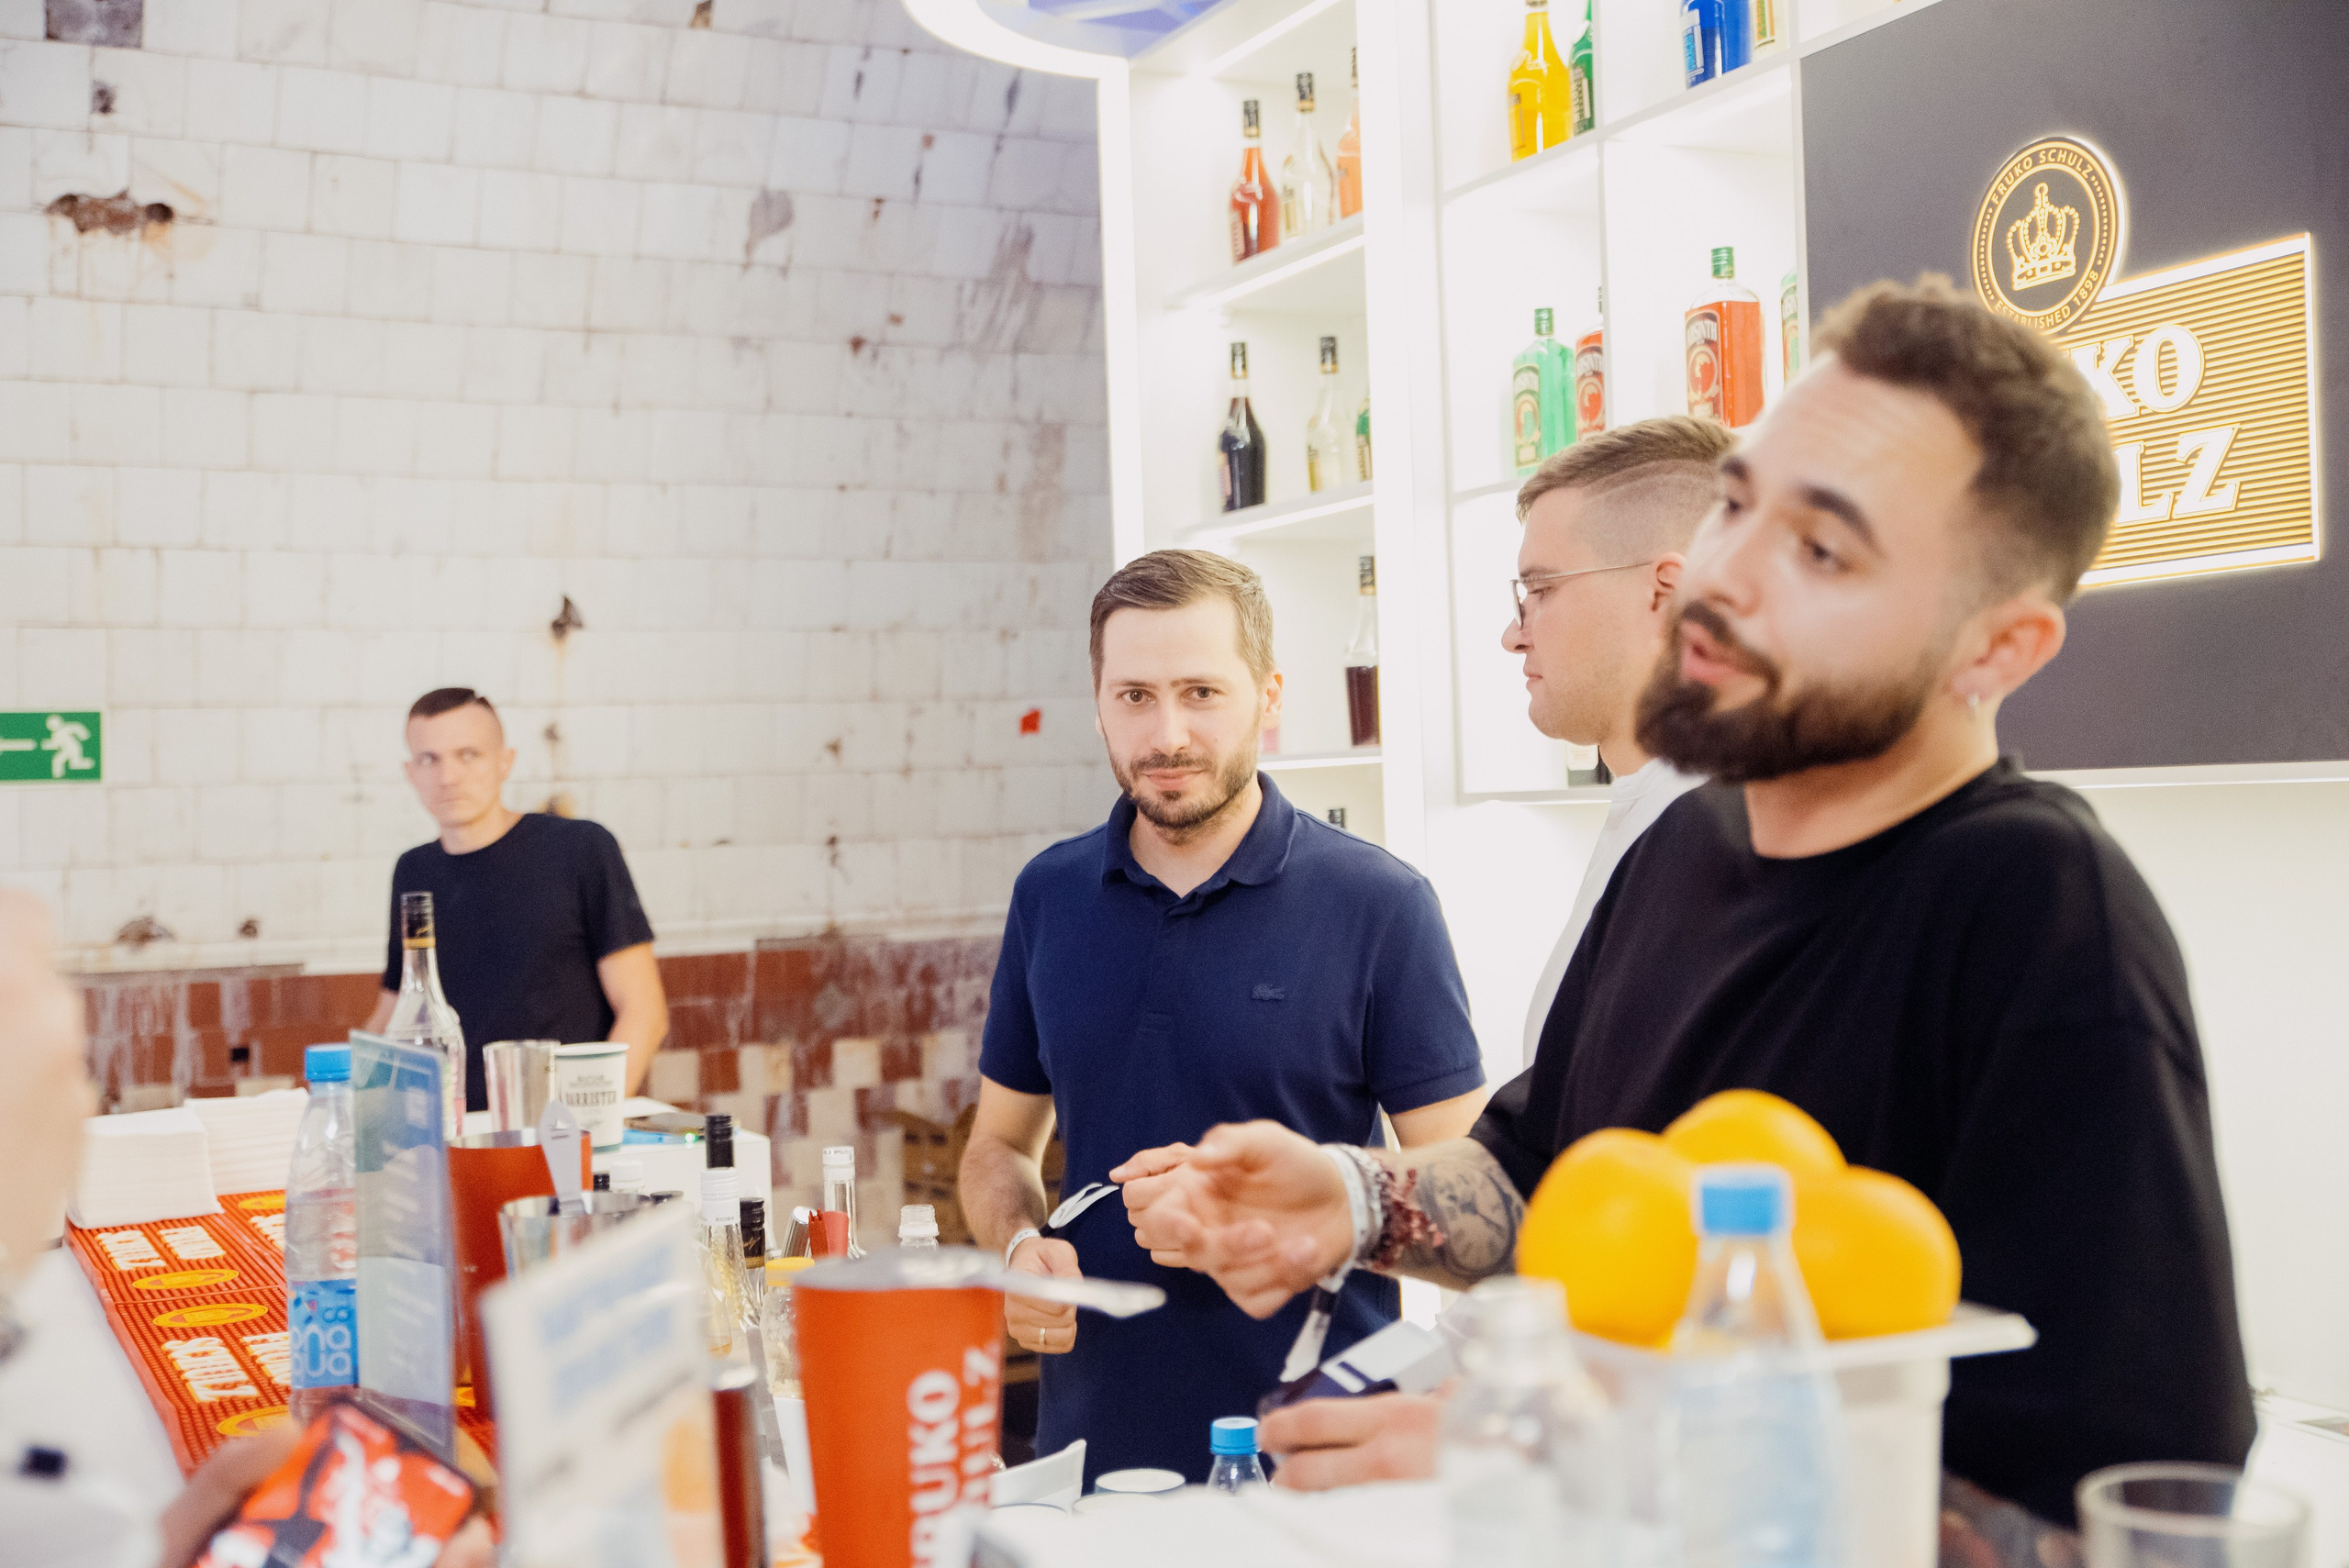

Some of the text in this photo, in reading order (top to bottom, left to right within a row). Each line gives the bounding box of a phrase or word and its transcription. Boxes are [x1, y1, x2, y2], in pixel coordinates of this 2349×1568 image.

[1991, 149, 2093, 205] FRUKO SCHULZ
[2074, 270, 2099, 306] 1898
[161, 1337, 260, 1402] SCHULZ
